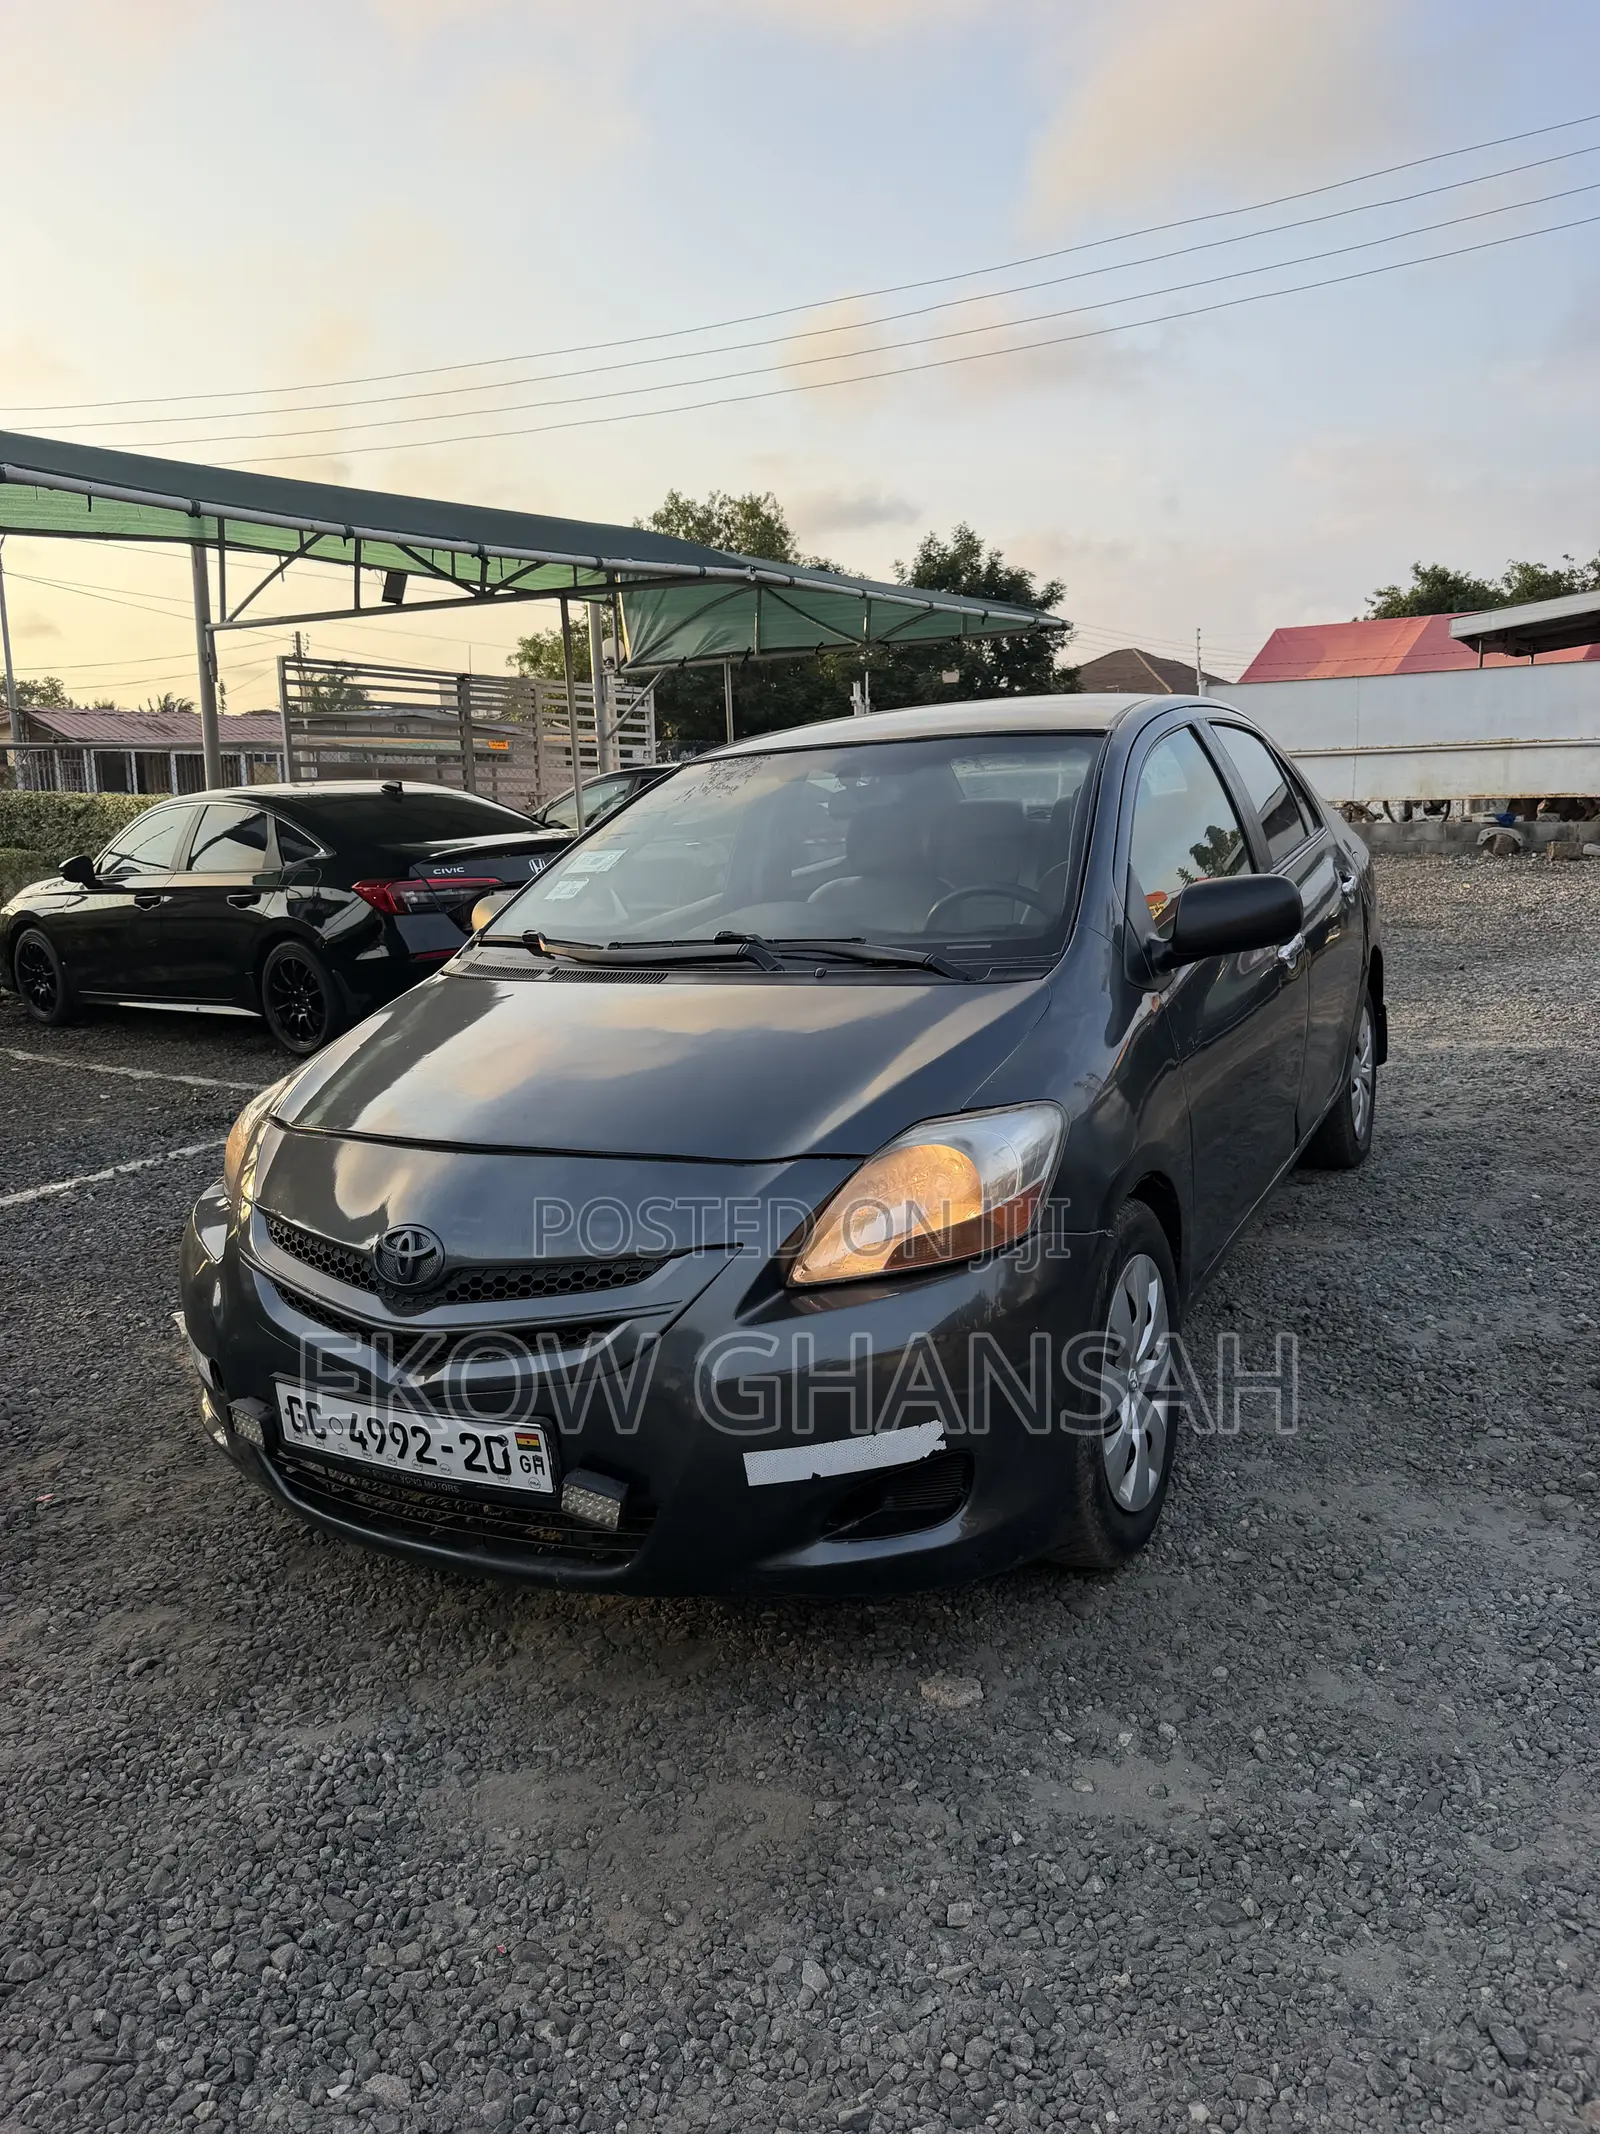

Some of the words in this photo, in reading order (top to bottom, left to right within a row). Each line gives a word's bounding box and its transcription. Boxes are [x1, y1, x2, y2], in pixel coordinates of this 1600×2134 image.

[433, 866, 465, 876] CIVIC
[286, 1394, 328, 1440] GC
[348, 1411, 513, 1476] 4992-20
[519, 1454, 546, 1476] GH
